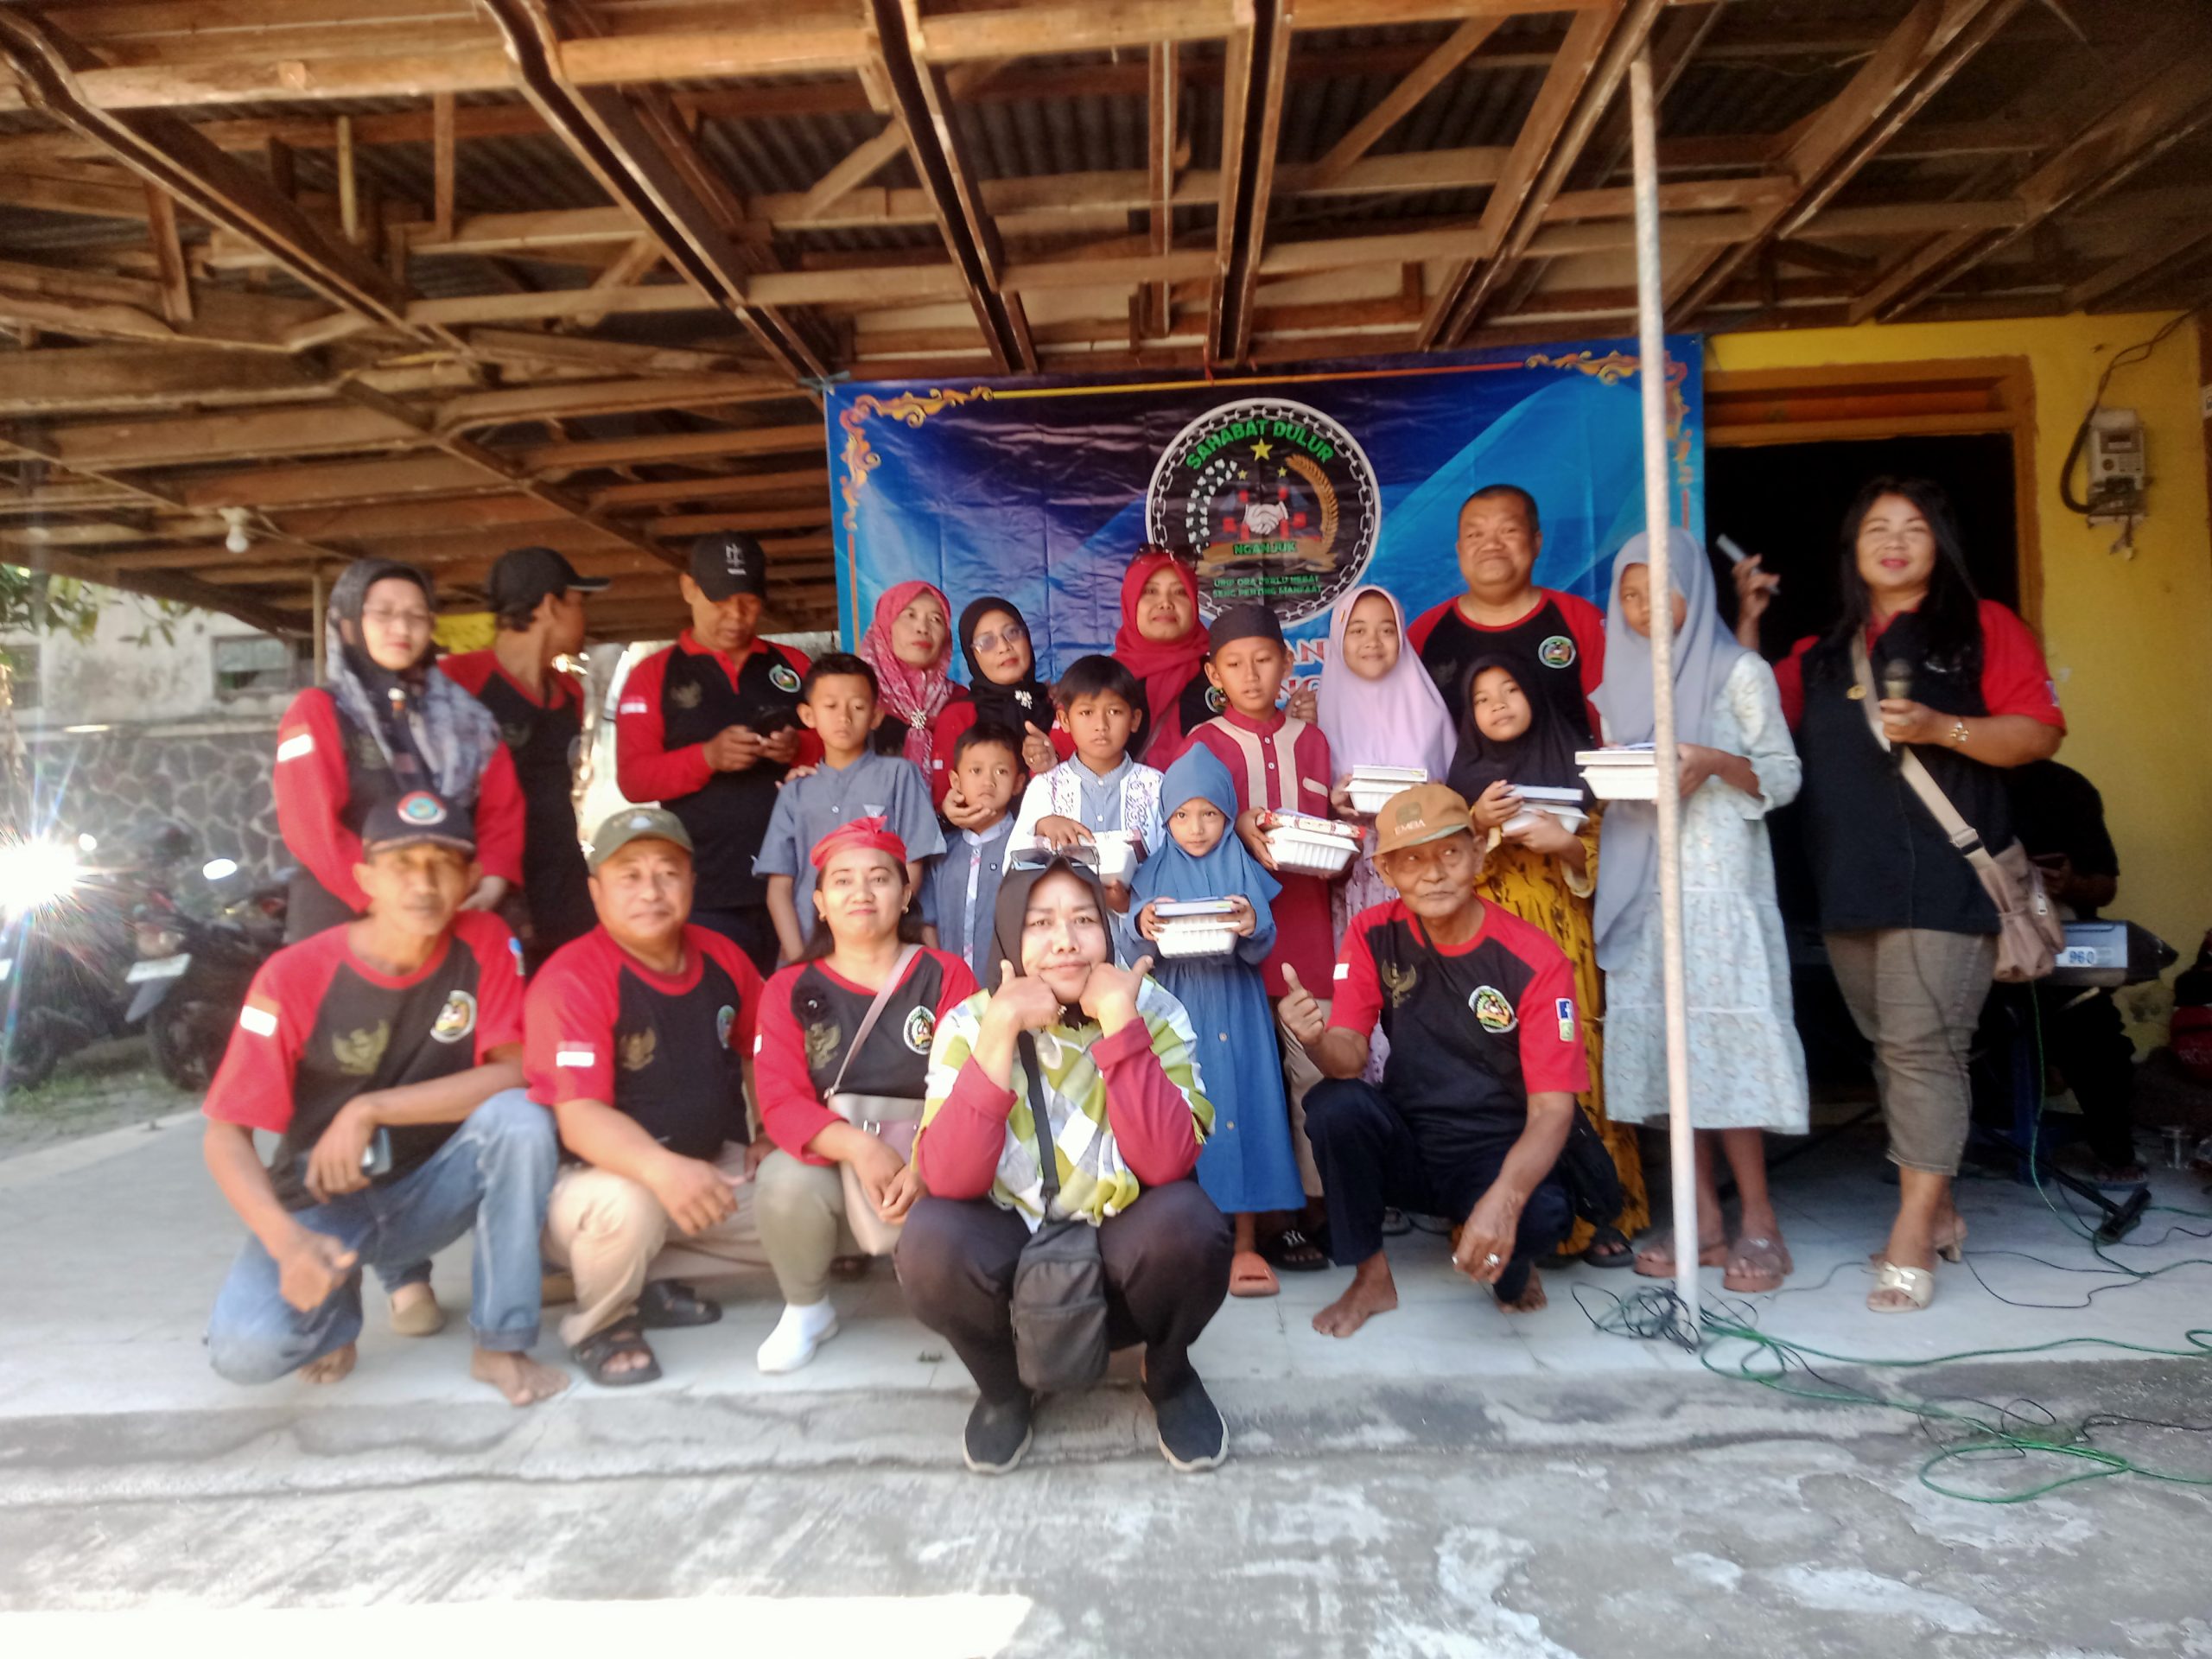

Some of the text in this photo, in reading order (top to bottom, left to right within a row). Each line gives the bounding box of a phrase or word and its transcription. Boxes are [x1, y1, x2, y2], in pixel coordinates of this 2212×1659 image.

[1185, 419, 1334, 470] SAHABAT DULUR
[1233, 541, 1297, 555] NGANJUK
